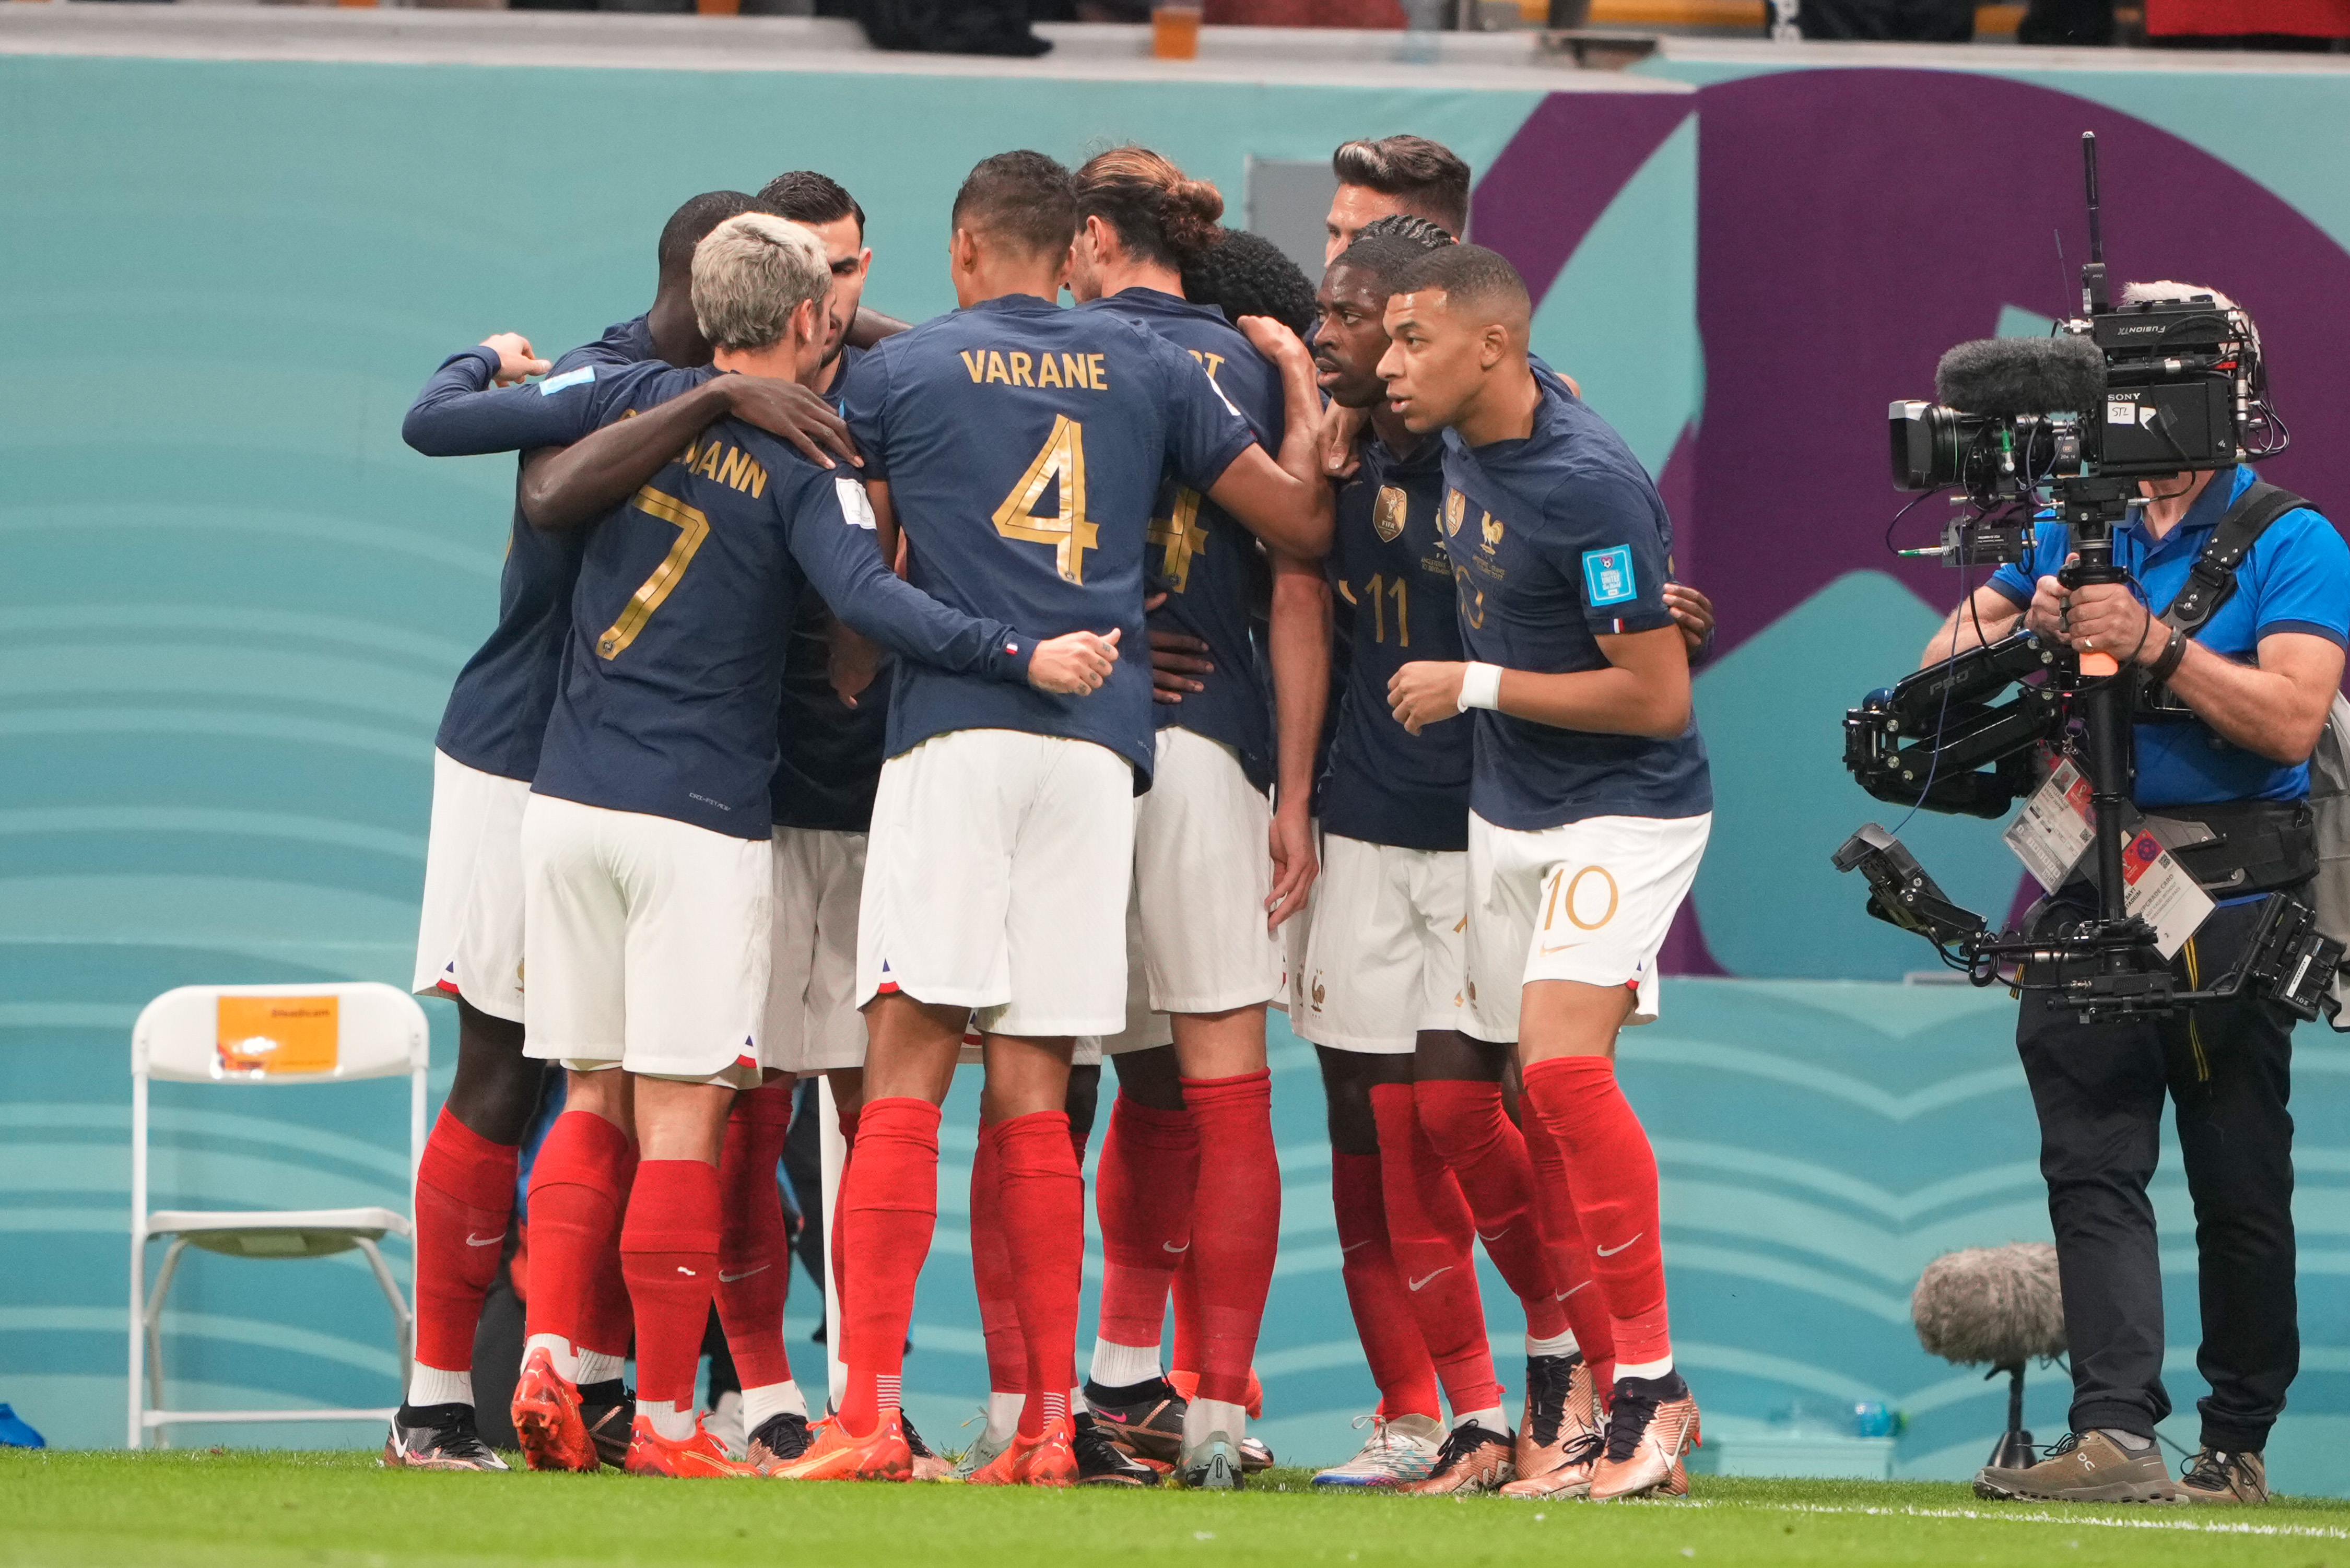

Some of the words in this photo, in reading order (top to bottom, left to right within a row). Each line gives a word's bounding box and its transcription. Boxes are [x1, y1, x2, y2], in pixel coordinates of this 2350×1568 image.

[960, 349, 1108, 391] VARANE
[2108, 393, 2141, 401] SONY
[992, 414, 1100, 587] 4
[1382, 520, 1394, 529] FIFA
[596, 485, 710, 661] 7
[1364, 573, 1409, 647] 11
[1544, 865, 1618, 930] 10
[2125, 887, 2136, 900] BAYT
[2160, 874, 2174, 890] CARD
[2145, 908, 2154, 918] NOT
[2153, 897, 2164, 910] VALID
